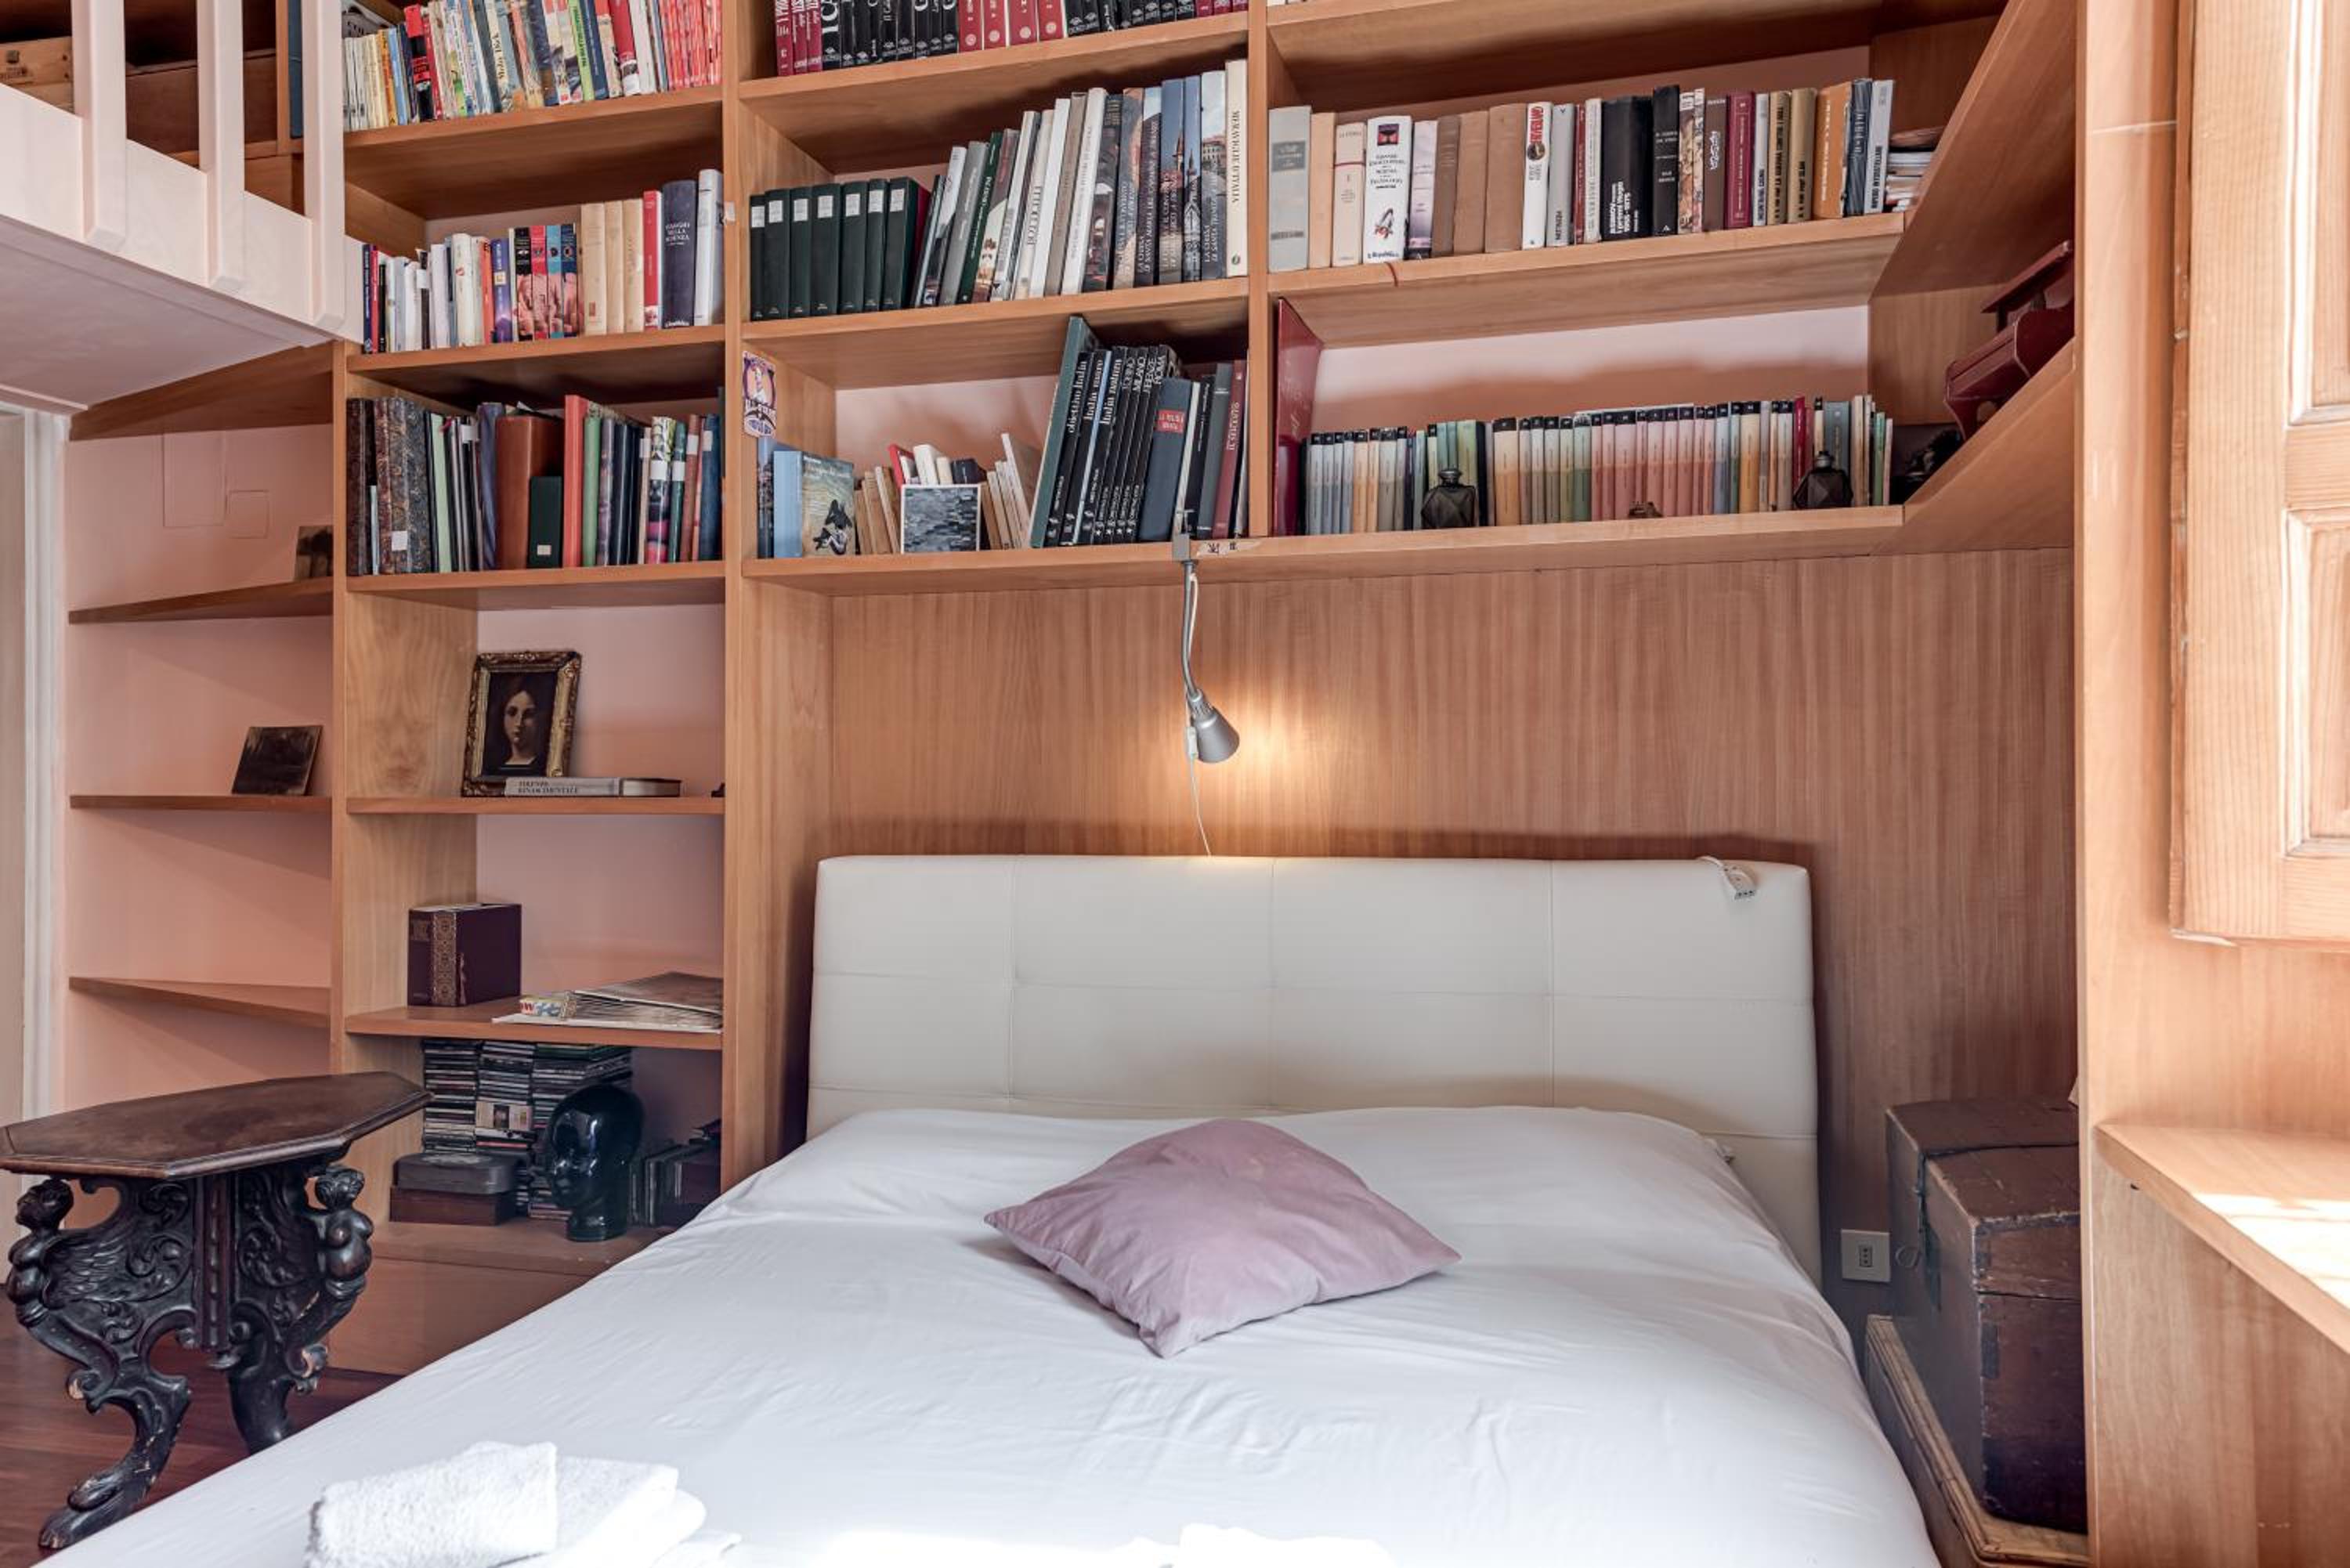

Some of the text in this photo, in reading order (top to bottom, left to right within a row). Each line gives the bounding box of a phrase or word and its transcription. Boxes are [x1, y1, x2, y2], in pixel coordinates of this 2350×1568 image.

[1231, 110, 1240, 163] MERAVIGLIE
[1026, 185, 1043, 245] BOTTICELLI
[1072, 360, 1088, 390] Italia
[1133, 356, 1144, 392] MILANO
[1154, 356, 1166, 385] ROMA
[1083, 392, 1097, 421] Italia
[1100, 396, 1115, 425] Italia
